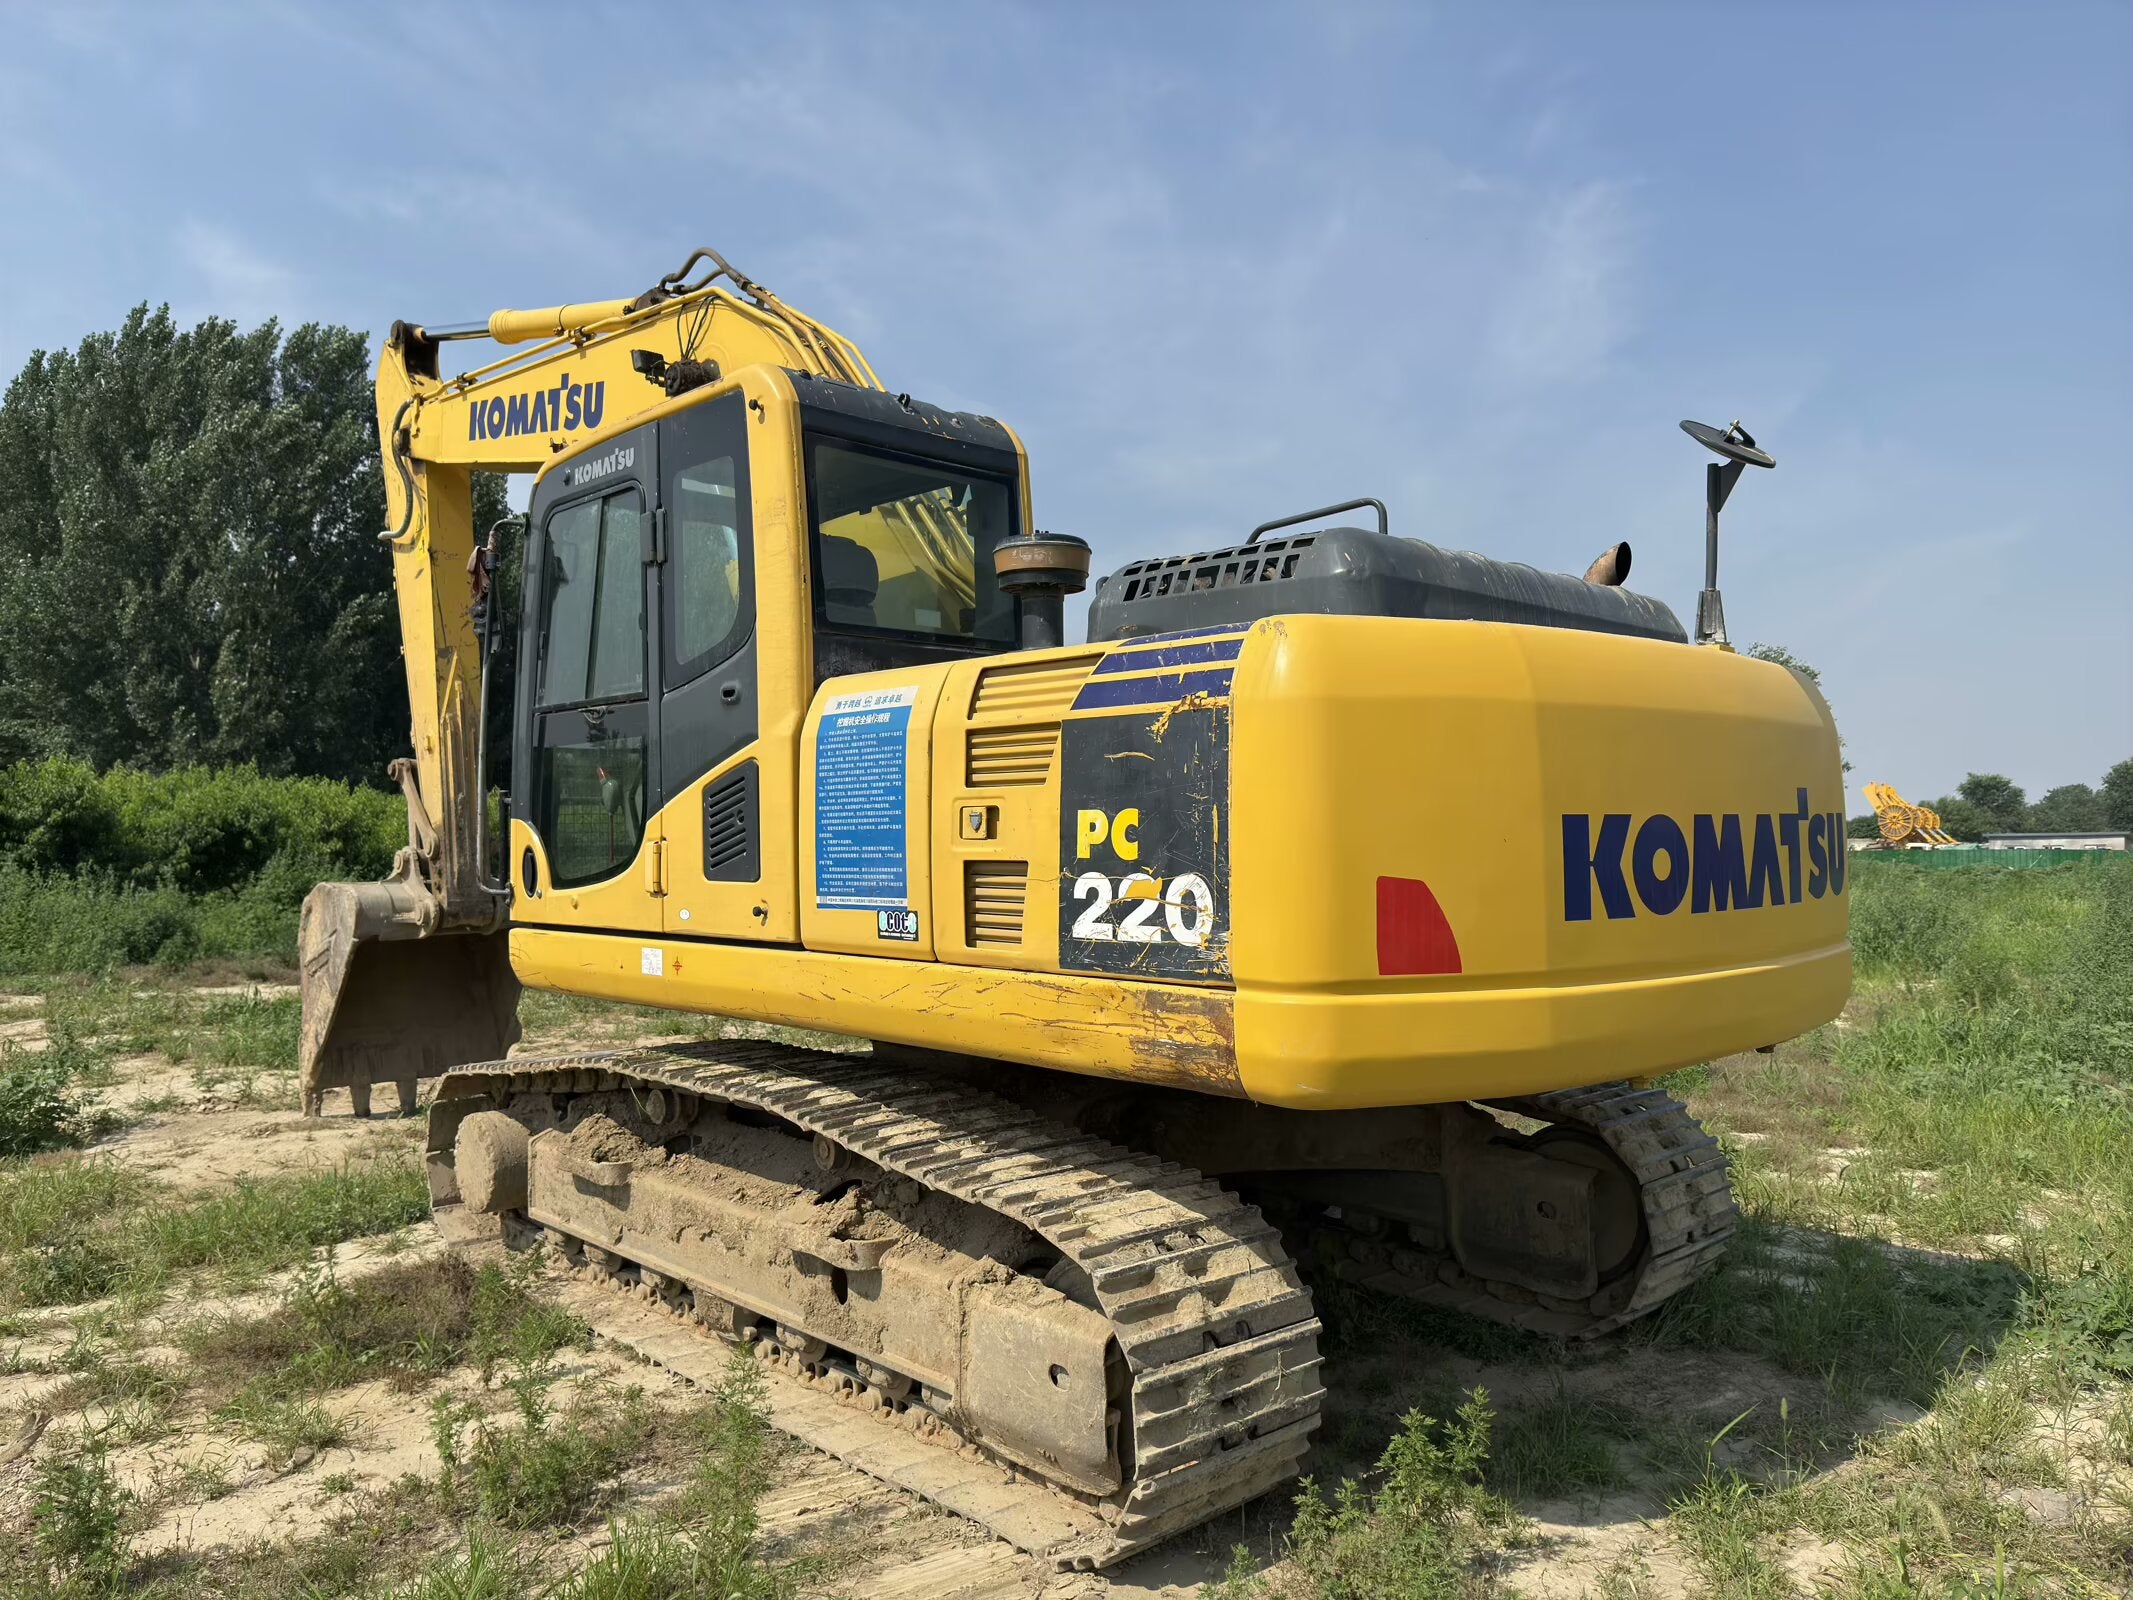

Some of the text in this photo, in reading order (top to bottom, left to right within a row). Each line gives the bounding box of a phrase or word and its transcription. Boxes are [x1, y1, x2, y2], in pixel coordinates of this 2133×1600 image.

[469, 373, 605, 441] KOMATSU
[574, 447, 635, 486] KOMATSU
[1077, 808, 1139, 861] PC
[1562, 787, 1845, 922] KOMATSU
[1072, 871, 1214, 947] 220
